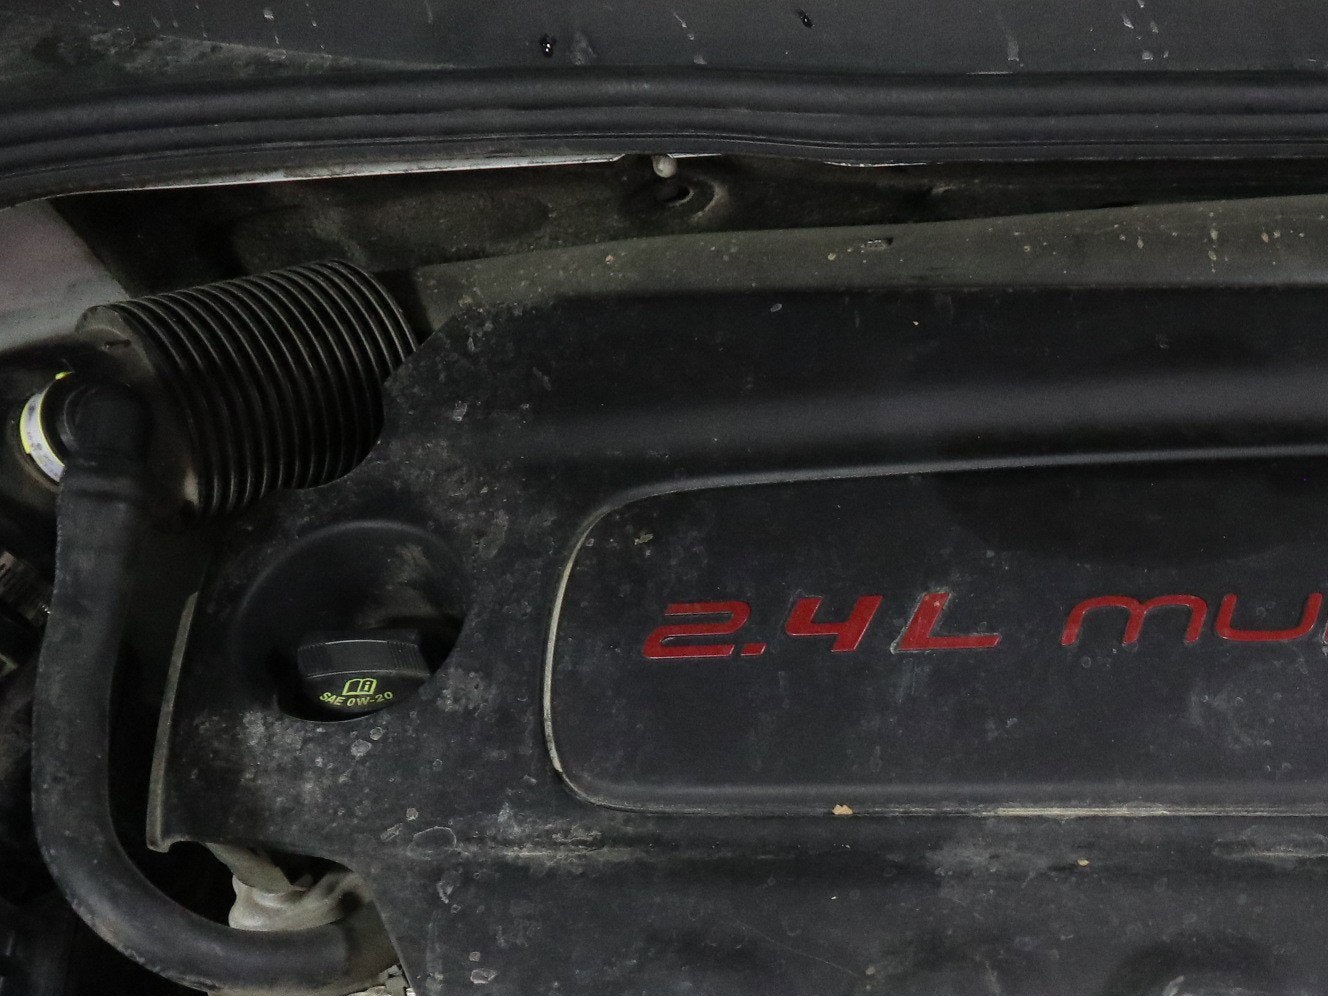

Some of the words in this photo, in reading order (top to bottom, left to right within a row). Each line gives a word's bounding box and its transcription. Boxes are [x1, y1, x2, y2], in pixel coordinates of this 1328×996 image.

[641, 591, 1002, 662] 2.4L
[319, 692, 346, 706] SAE
[347, 691, 394, 707] 0W-20
